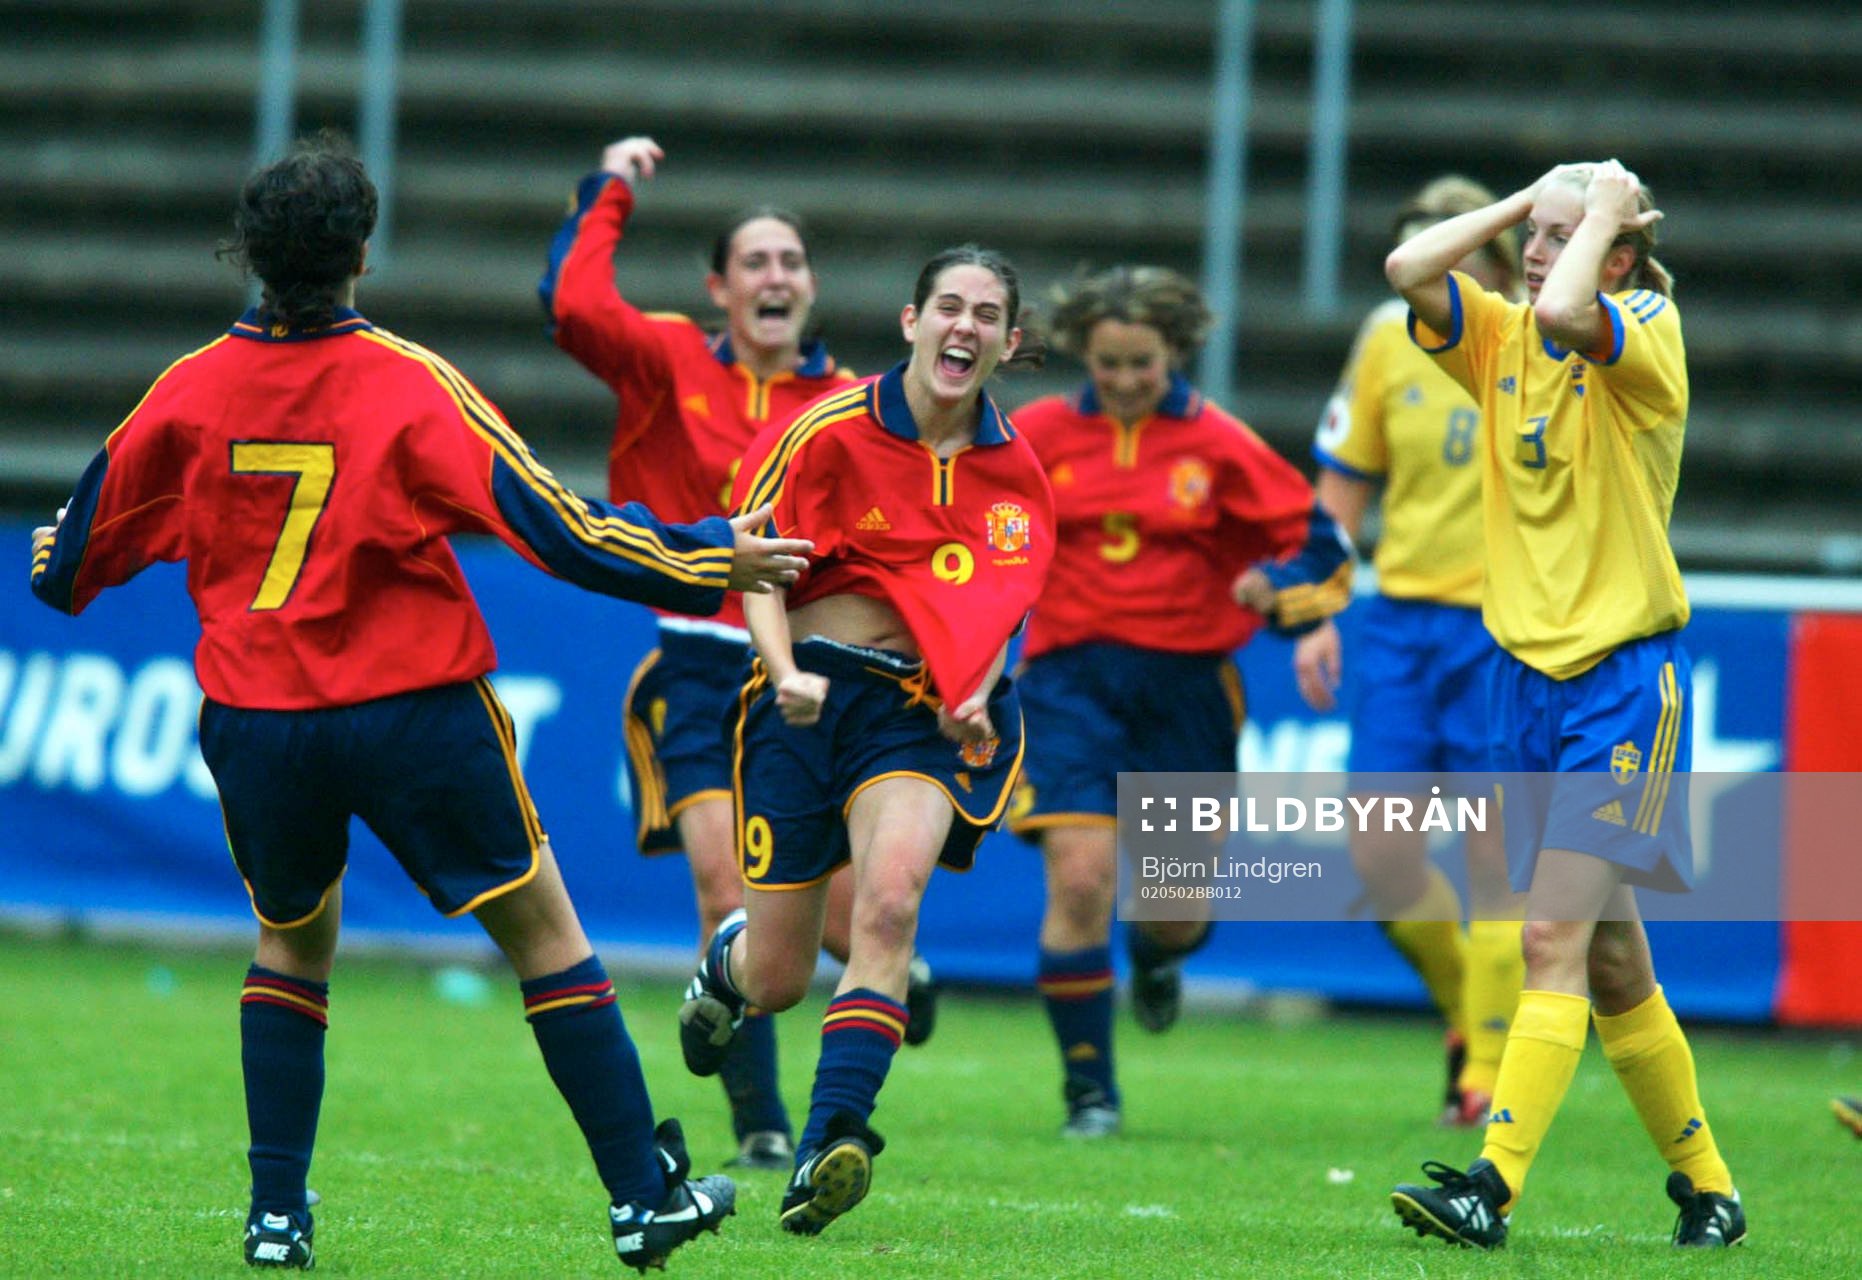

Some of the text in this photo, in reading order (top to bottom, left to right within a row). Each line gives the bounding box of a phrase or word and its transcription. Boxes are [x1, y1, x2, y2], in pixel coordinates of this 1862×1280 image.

[229, 440, 338, 612] 7
[1100, 512, 1140, 563] 5
[931, 543, 975, 586] 9
[746, 815, 774, 879] 9
